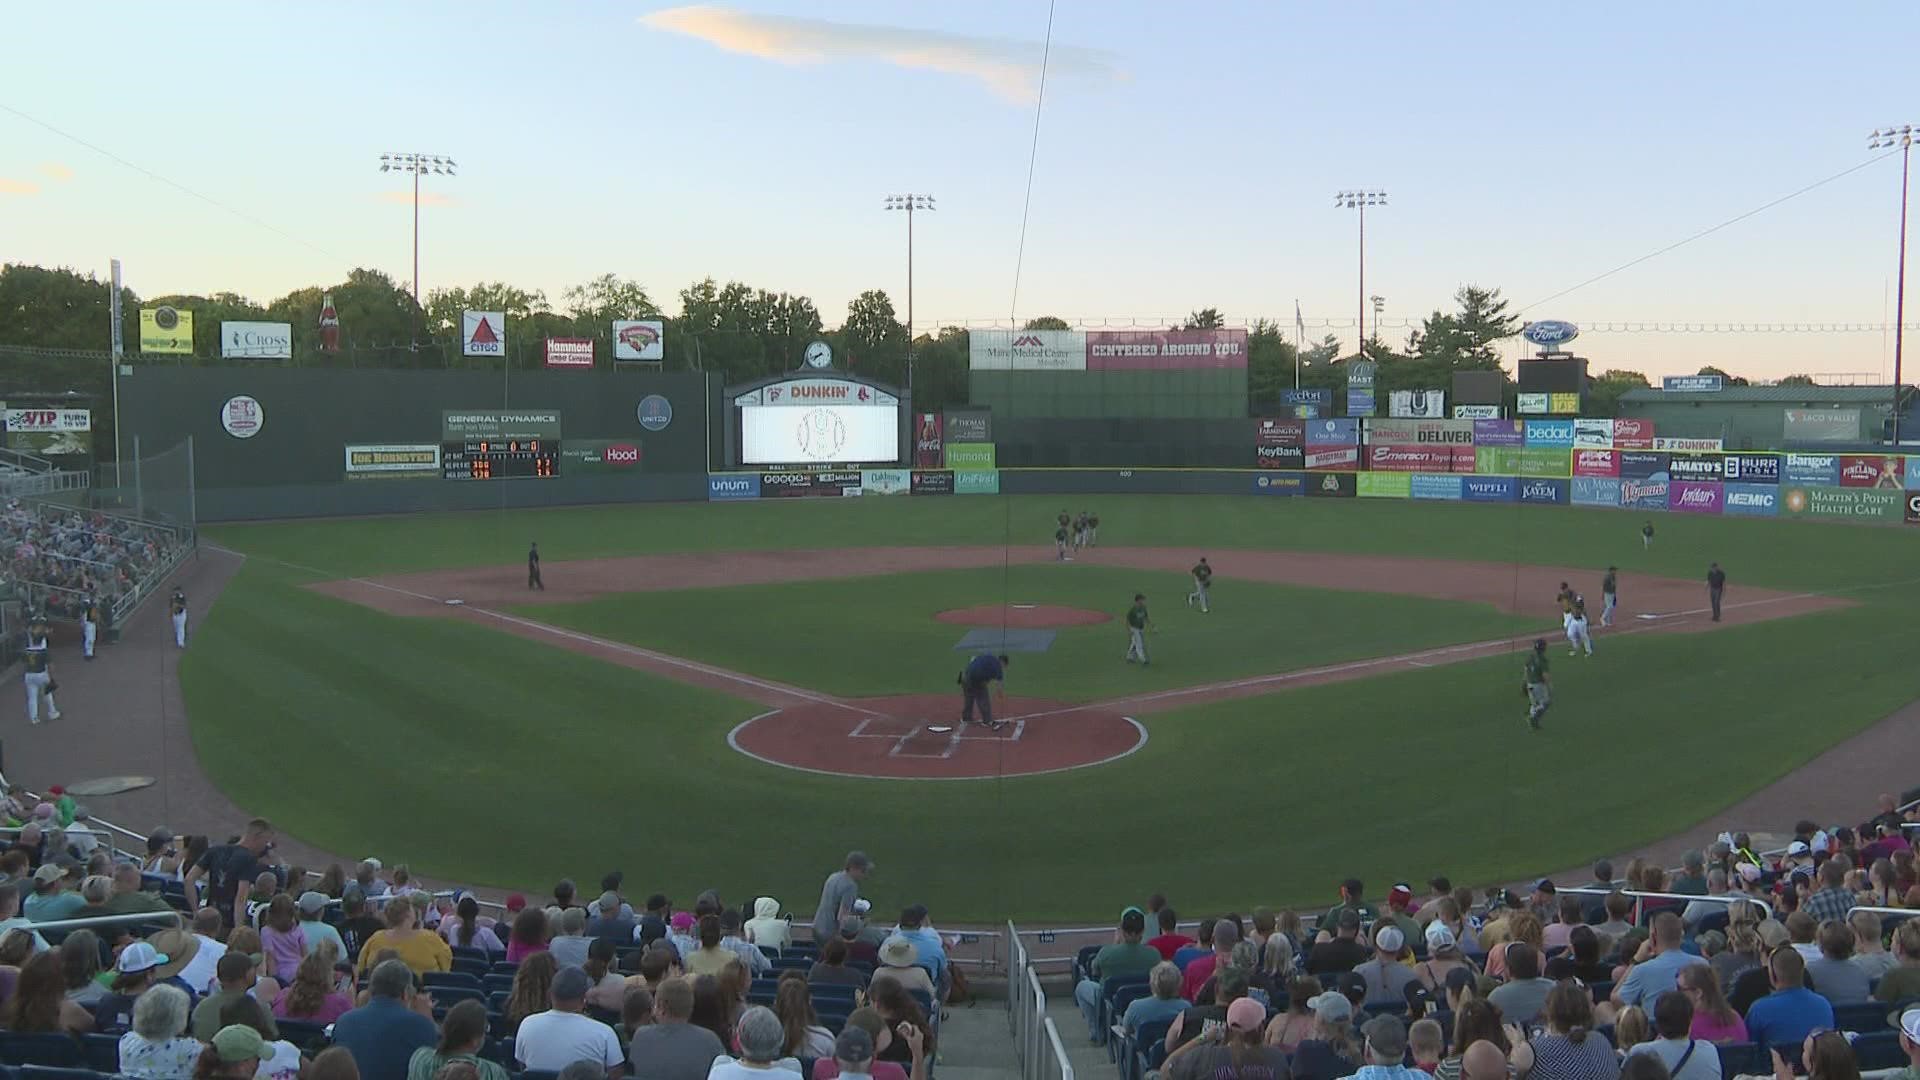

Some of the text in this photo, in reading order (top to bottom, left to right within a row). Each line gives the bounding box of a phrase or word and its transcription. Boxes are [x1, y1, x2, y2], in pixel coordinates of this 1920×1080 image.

[244, 331, 288, 346] CROSS
[1531, 326, 1565, 341] Ford
[470, 344, 498, 352] CITGO
[547, 339, 593, 353] Hammond
[1092, 343, 1243, 357] CENTERED AROUND YOU.
[1013, 348, 1043, 358] Medical
[1348, 376, 1373, 384] MAST
[791, 386, 849, 398] DUNKIN'
[1465, 406, 1493, 416] Norway
[25, 411, 57, 425] VIP
[1828, 414, 1856, 422] VALLEY
[1418, 431, 1472, 443] DELIVER
[1527, 425, 1572, 439] bedard
[1678, 440, 1719, 449] DUNKIN'
[607, 449, 638, 460] Hood
[1258, 447, 1302, 457] KeyBank
[1670, 461, 1722, 472] AMATO'S
[1786, 454, 1834, 468] Bangor
[1843, 466, 1878, 476] PINELAND
[711, 480, 750, 491] unum
[1469, 483, 1507, 492] WIPFLI
[1621, 480, 1666, 503] Wyman's
[1522, 485, 1556, 500] KAYEM
[1677, 488, 1716, 505] Jordan's
[1811, 491, 1895, 505] MARTIN'S POINT
[1727, 493, 1774, 507] MEMIC
[1811, 503, 1883, 515] HEALTH CARE
